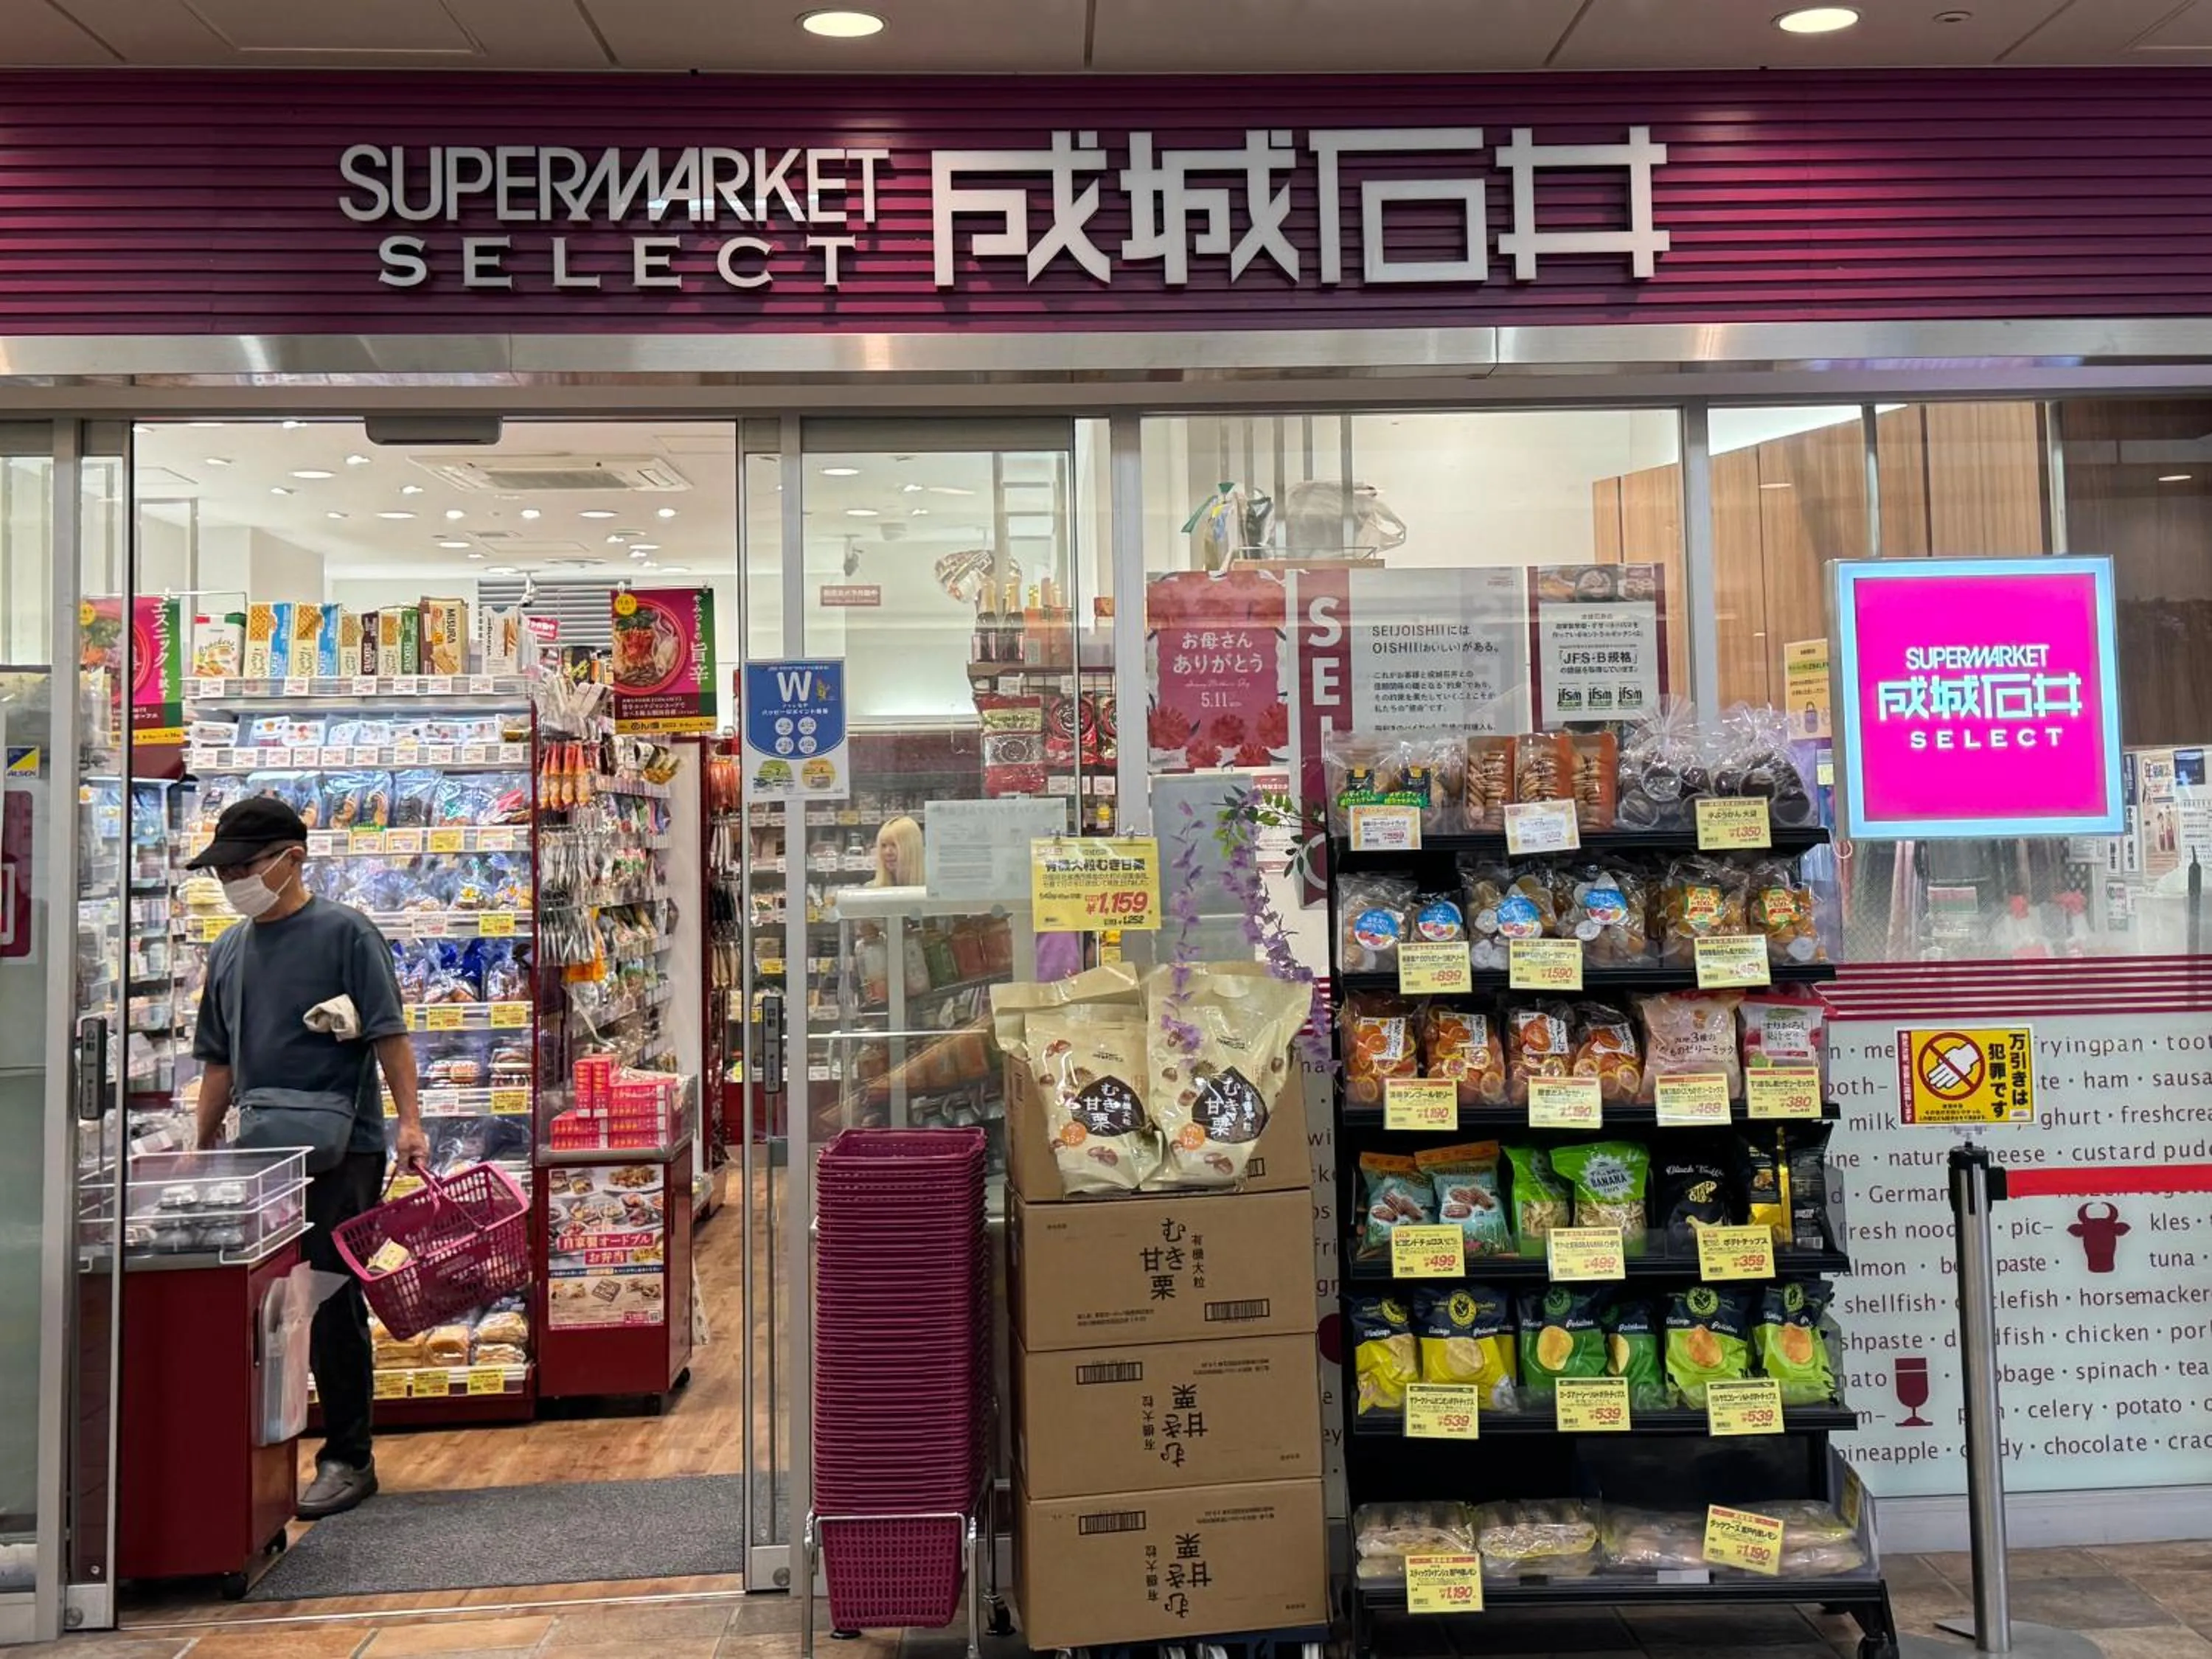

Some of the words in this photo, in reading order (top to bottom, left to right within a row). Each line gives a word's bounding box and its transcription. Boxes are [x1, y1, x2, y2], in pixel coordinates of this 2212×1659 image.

[340, 144, 891, 225] SUPERMARKET
[931, 125, 1671, 287] 成城石井
[378, 235, 858, 290] SELECT
[446, 608, 456, 644] MISURA
[1182, 631, 1253, 650] お母さん
[1172, 653, 1263, 674] ありがとう
[1905, 644, 2050, 670] SUPERMARKET
[777, 670, 812, 702] W
[1877, 672, 2082, 722] 成城石井
[1200, 692, 1228, 708] 5.11
[1910, 728, 2063, 750] SELECT
[2034, 1034, 2143, 1057] ryingpan
[2008, 1033, 2028, 1105] 万引きは
[2084, 1070, 2129, 1090] ham
[1988, 1043, 2007, 1118] 犯罪です
[1787, 1095, 1812, 1107] 380
[1848, 1113, 1898, 1131] milk
[2040, 1107, 2101, 1130] ghurt
[2072, 1141, 2156, 1161] custard
[2150, 1213, 2191, 1231] kles
[589, 1250, 625, 1264] お弁当
[1191, 1233, 1206, 1289] 有機大粒
[1430, 1254, 1456, 1267] 499
[1997, 1255, 2047, 1276] paste
[2149, 1252, 2195, 1268] tuna
[1844, 1293, 1936, 1314] shellfish
[2065, 1324, 2149, 1344] chicken
[2076, 1359, 2157, 1383] spinach
[2178, 1360, 2209, 1376] tea
[1596, 1408, 1621, 1420] 539
[1747, 1409, 1773, 1422] 539
[2028, 1399, 2093, 1420] celery
[2116, 1397, 2183, 1419] potato
[1444, 1416, 1470, 1427] 539
[2044, 1434, 2148, 1455] chocolate
